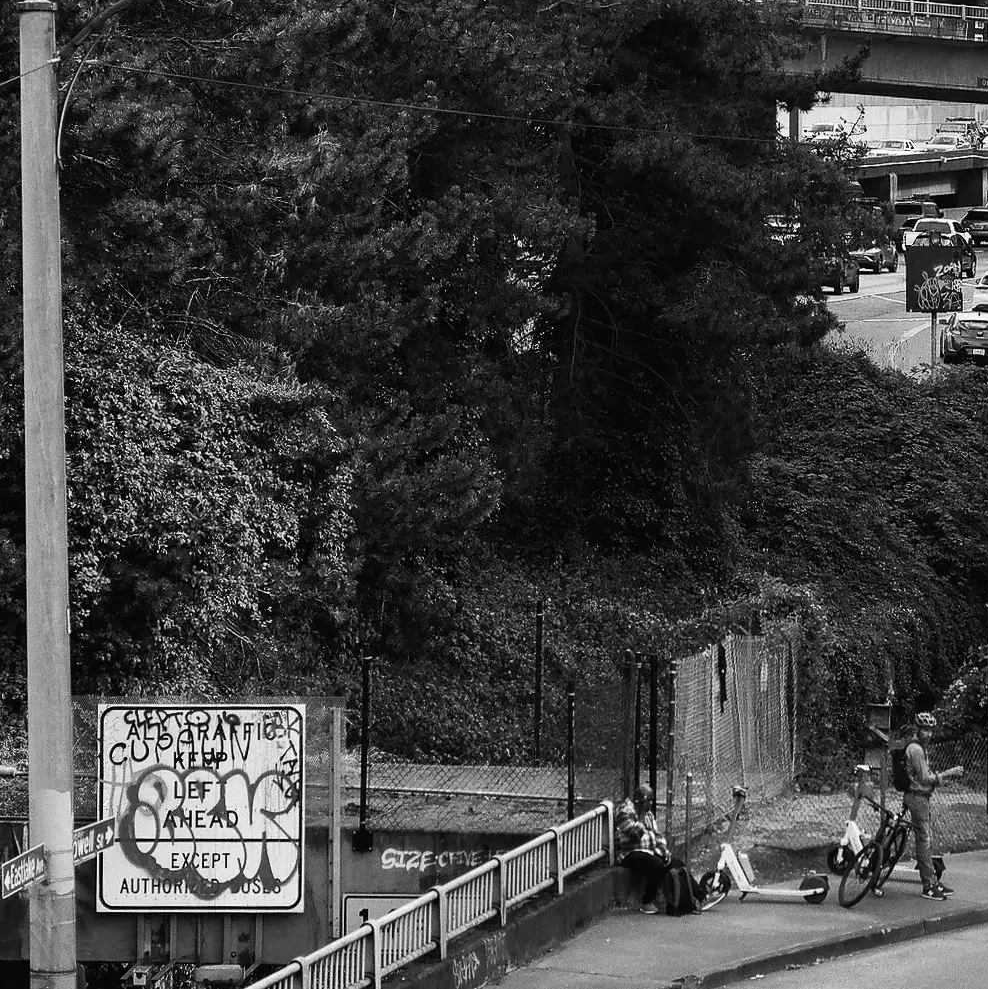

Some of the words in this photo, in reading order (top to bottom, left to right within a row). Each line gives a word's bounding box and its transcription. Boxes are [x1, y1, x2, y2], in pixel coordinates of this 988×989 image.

[163, 810, 239, 828] AHEAD
[73, 829, 95, 860] owell
[171, 853, 231, 869] EXCEPT
[119, 877, 220, 894] AUTHORID
